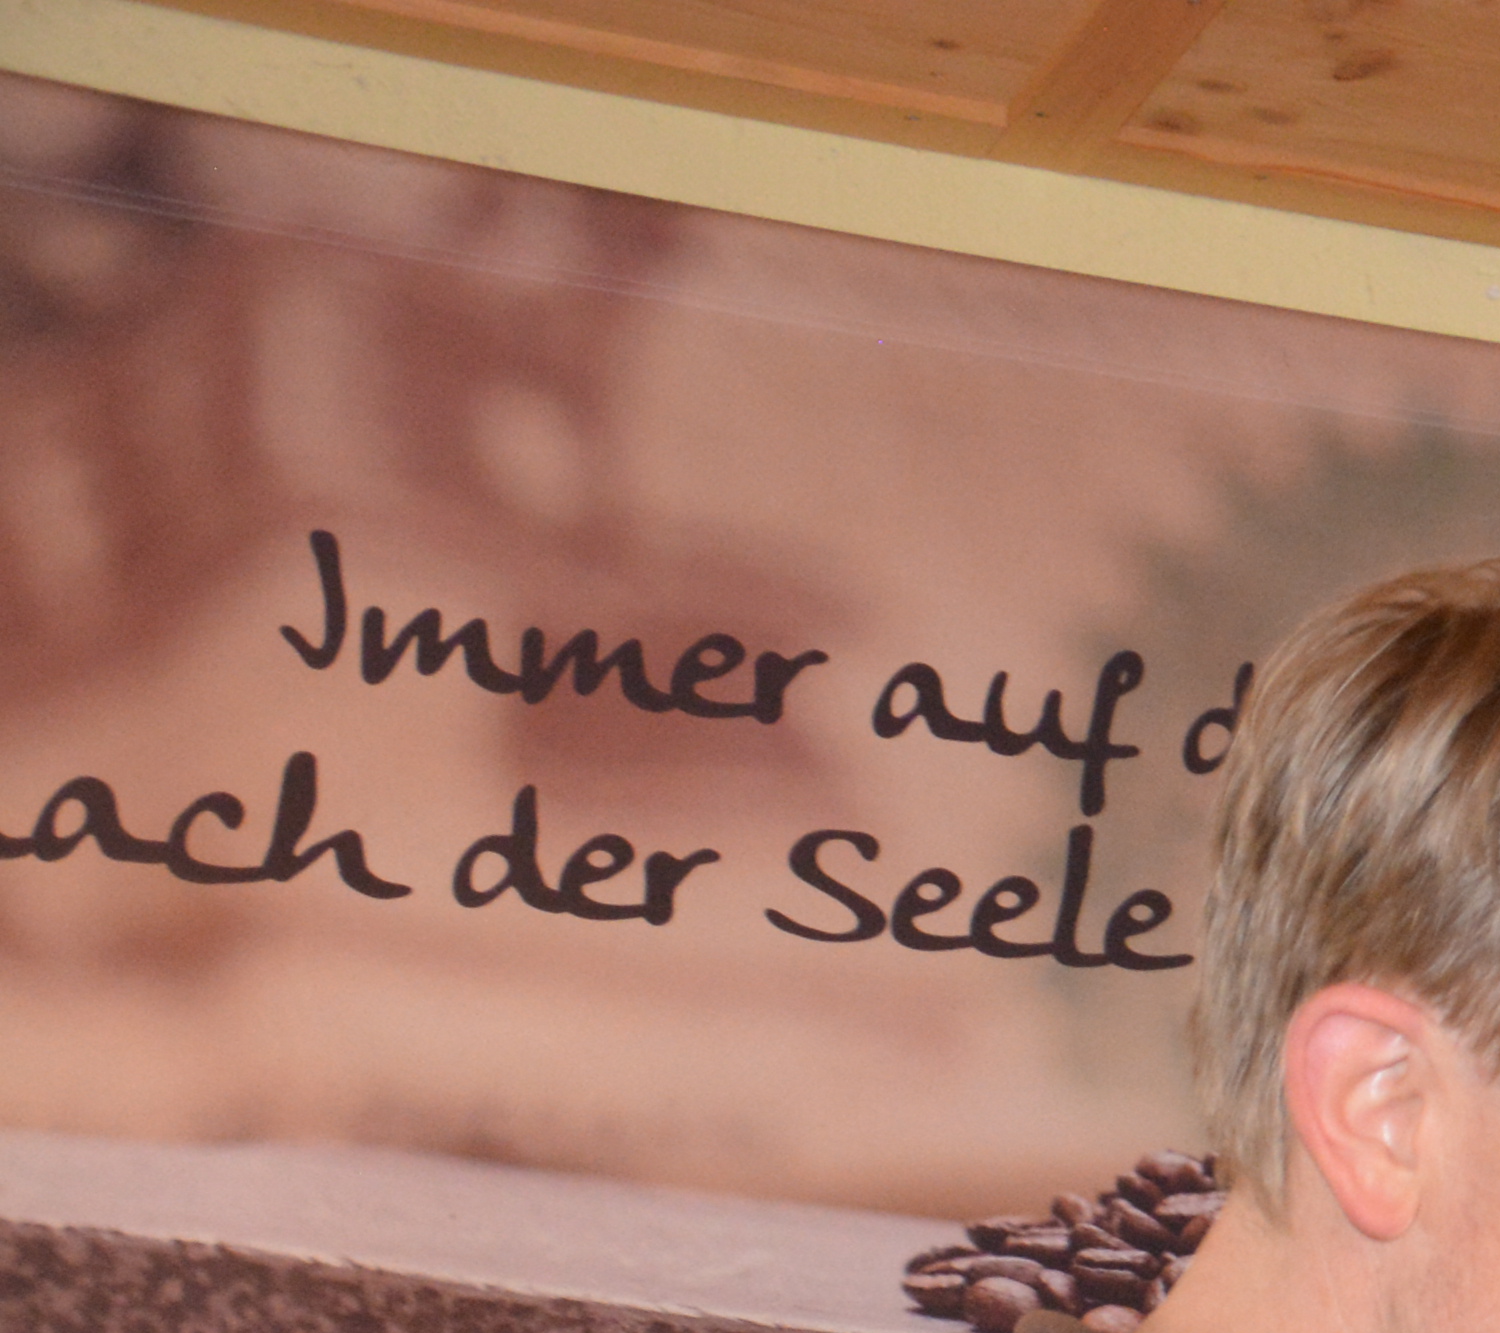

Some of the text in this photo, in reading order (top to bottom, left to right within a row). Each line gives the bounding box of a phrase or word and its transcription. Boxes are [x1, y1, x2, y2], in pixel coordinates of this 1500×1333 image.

[871, 650, 1146, 816] auf
[1182, 660, 1256, 776] d
[453, 784, 720, 927] der
[765, 824, 1195, 973] Seele
